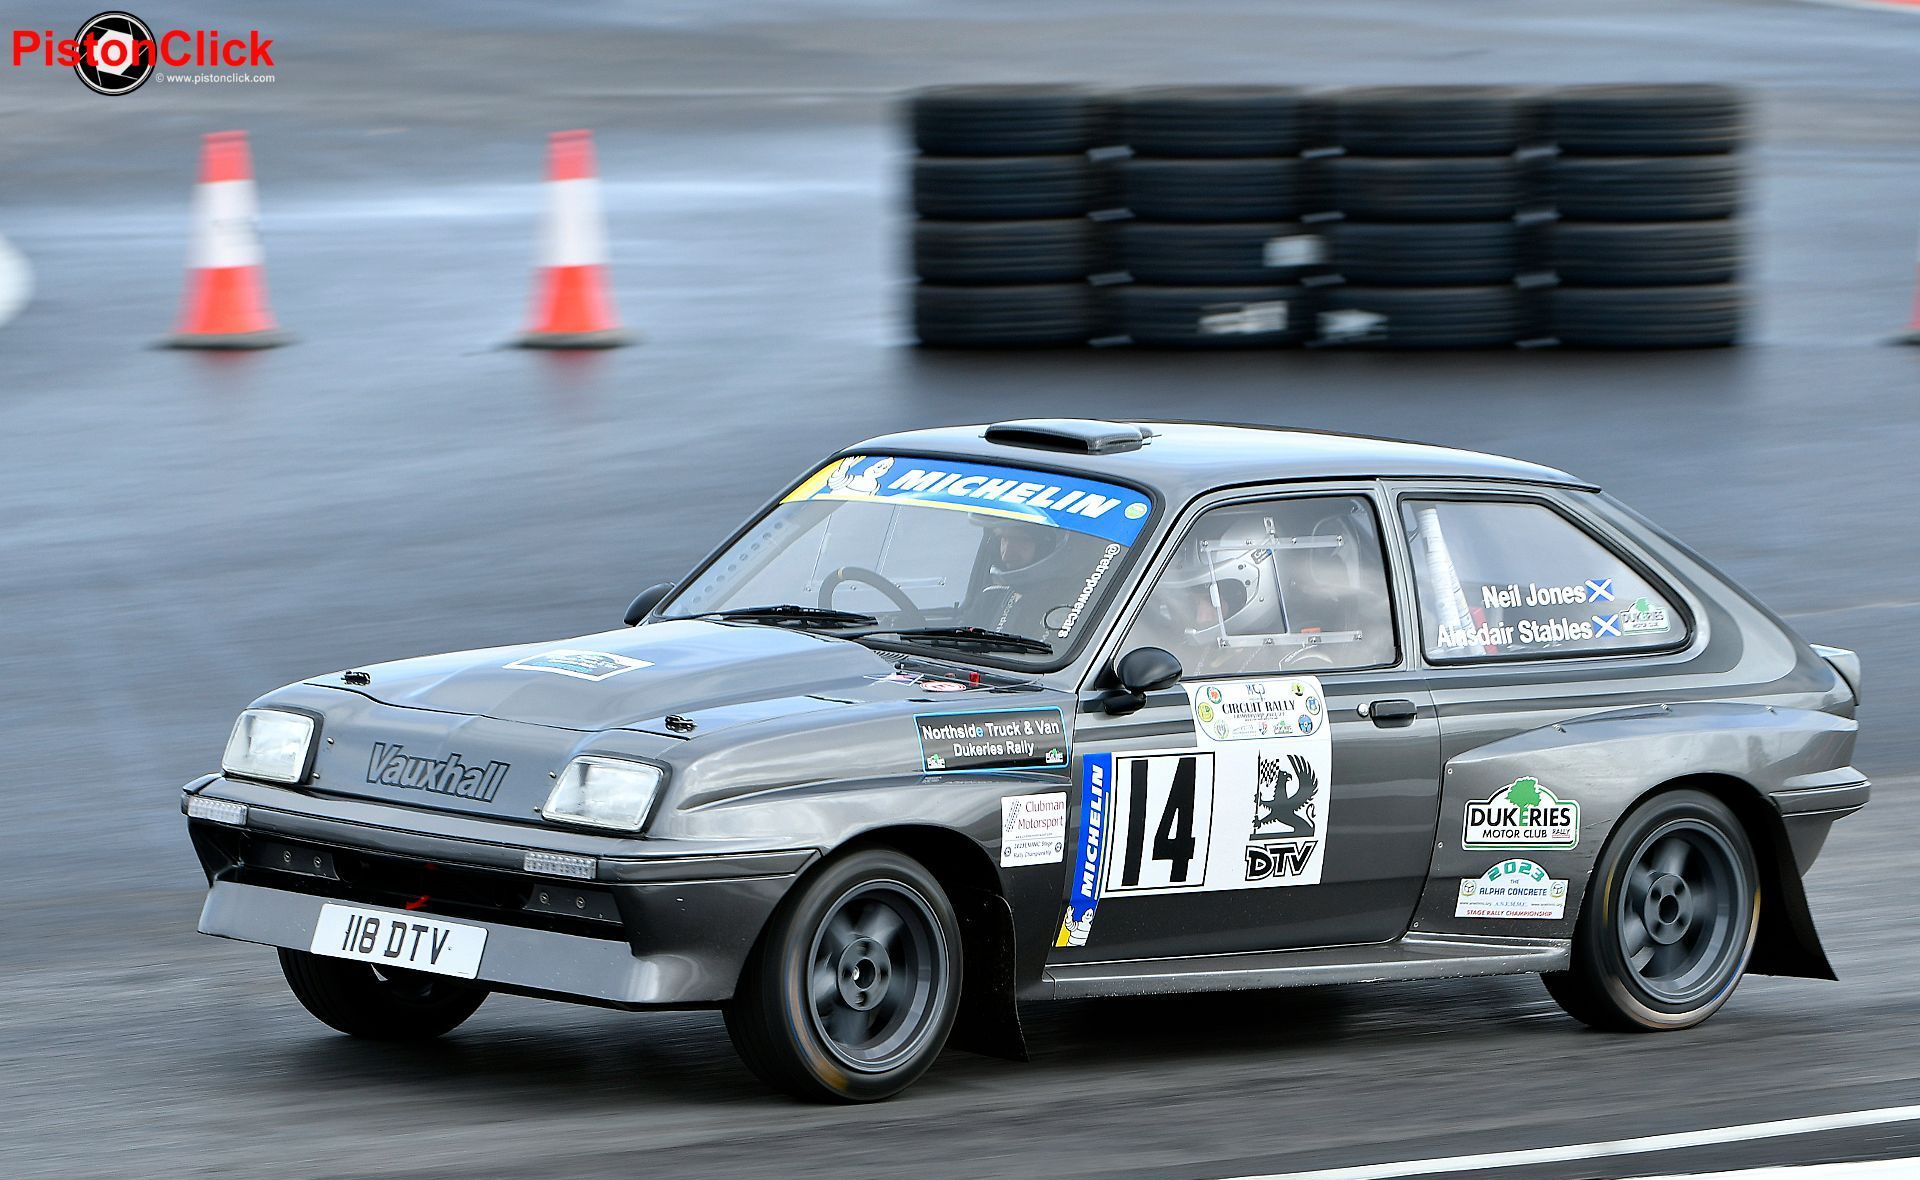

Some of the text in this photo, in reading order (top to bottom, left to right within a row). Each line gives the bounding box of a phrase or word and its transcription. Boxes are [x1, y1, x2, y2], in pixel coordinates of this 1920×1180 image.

[888, 470, 1121, 518] MICHELIN
[1057, 543, 1121, 638] @retropowercars
[1481, 583, 1587, 608] Neil Jones
[1437, 617, 1593, 648] Alasdair Stables
[1222, 700, 1295, 714] CIRCUIT RALLY
[922, 720, 1060, 740] Northside Truck & Van
[953, 740, 1034, 758] Dukeries Rally
[367, 741, 511, 803] Vauxhall
[1025, 800, 1064, 812] Clubman
[1470, 807, 1571, 827] DUKERIES
[1018, 816, 1063, 830] Motorsport
[1080, 765, 1104, 898] MICHELIN
[1121, 757, 1197, 886] 14
[1482, 829, 1520, 839] MOTOR
[1524, 829, 1548, 838] CLUB
[1245, 840, 1319, 881] DTV
[1487, 861, 1545, 882] 2023
[1479, 888, 1548, 896] ALPHA CONCRETE
[342, 913, 450, 965] 118 DTV
